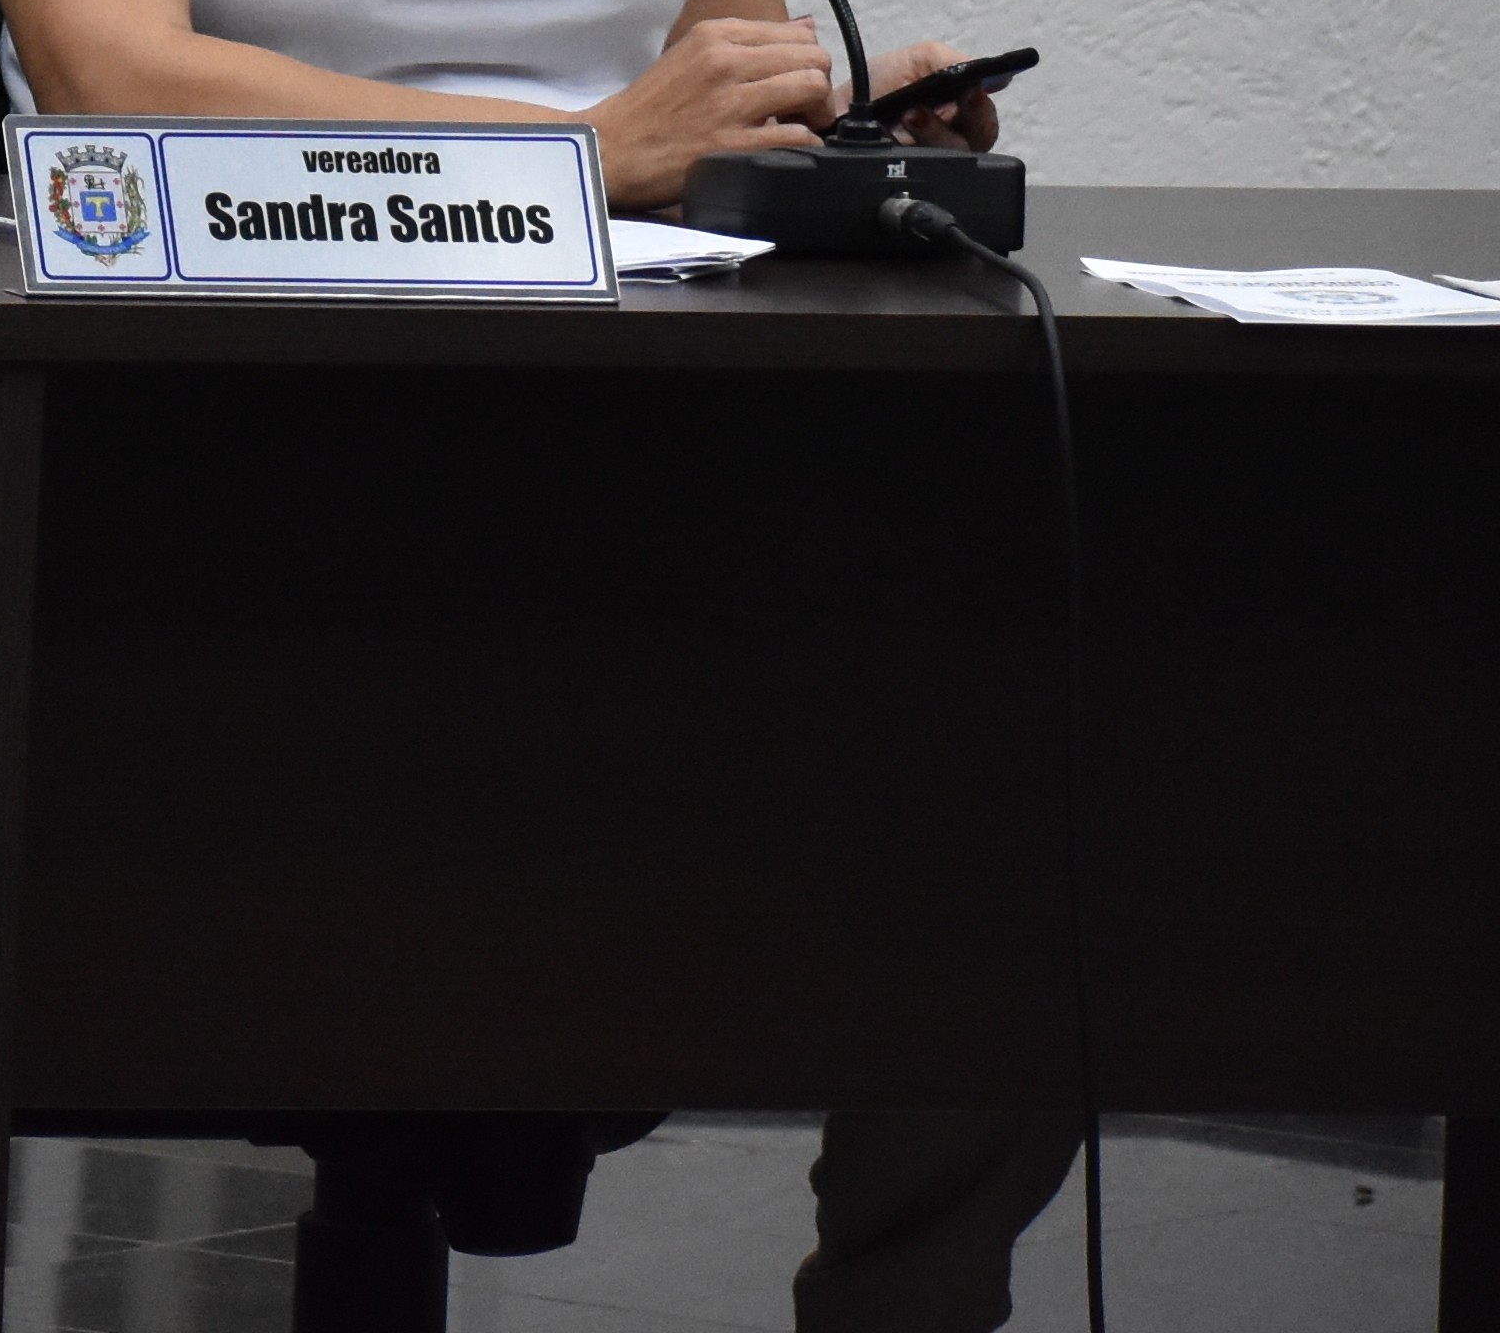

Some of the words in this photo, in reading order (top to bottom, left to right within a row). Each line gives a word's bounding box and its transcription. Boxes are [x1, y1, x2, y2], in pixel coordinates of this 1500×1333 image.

[301, 147, 442, 175] vereadora
[204, 191, 379, 243] Sandra
[386, 193, 555, 245] Santos
